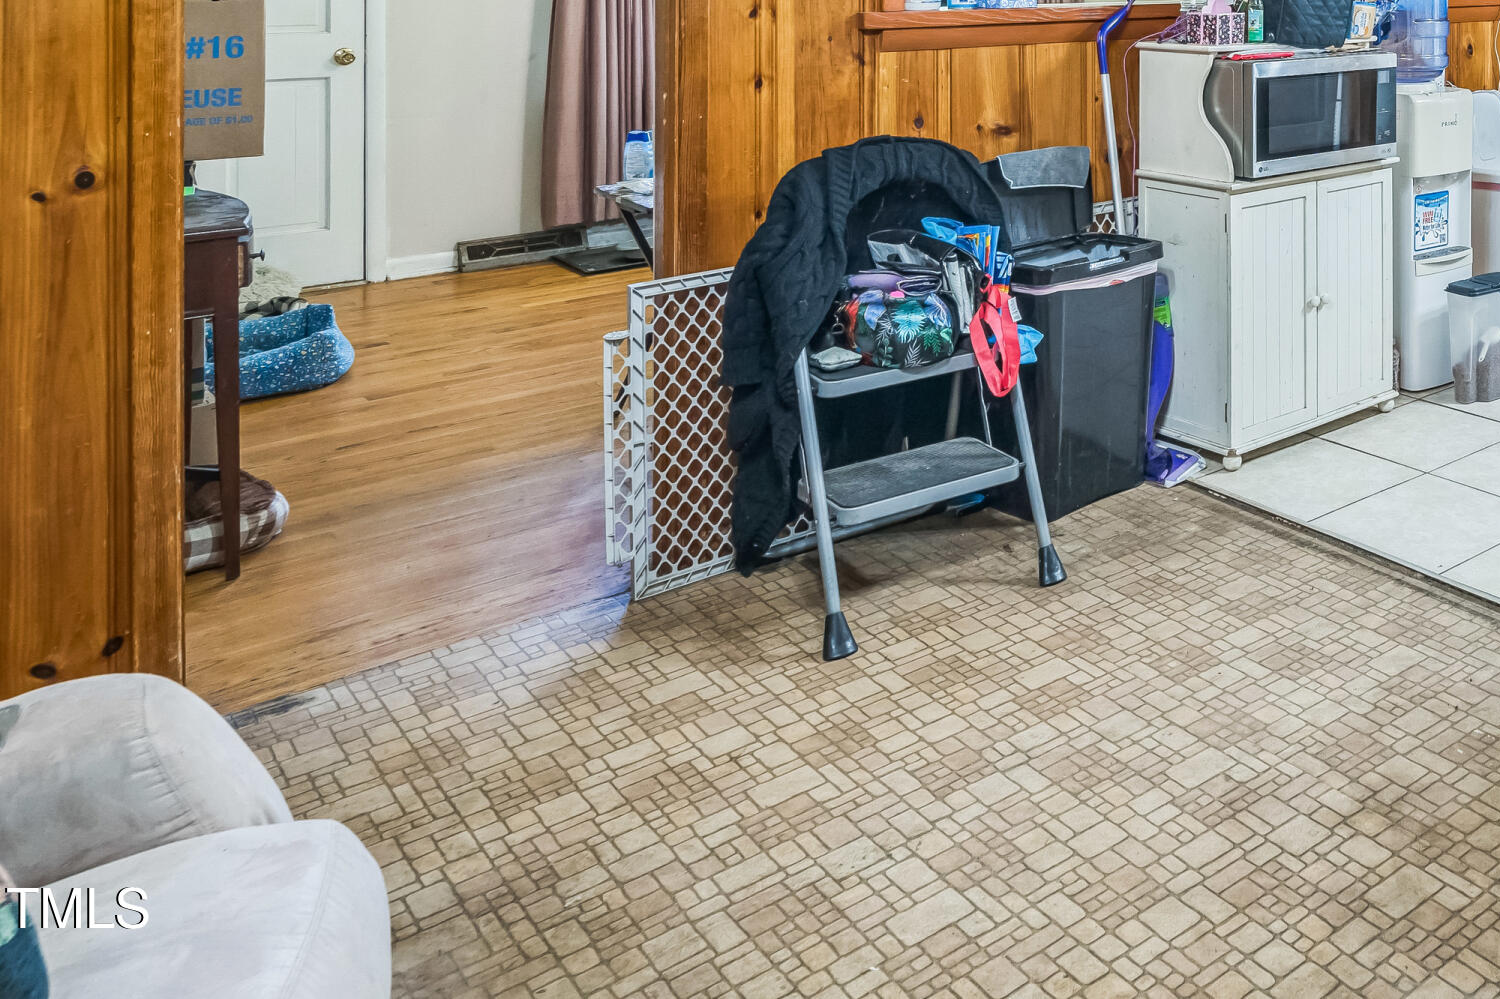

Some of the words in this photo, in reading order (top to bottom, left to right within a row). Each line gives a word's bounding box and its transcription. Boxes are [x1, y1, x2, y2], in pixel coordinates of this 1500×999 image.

[185, 35, 245, 59] #16
[184, 88, 243, 109] EUSE
[185, 117, 206, 126] AGE
